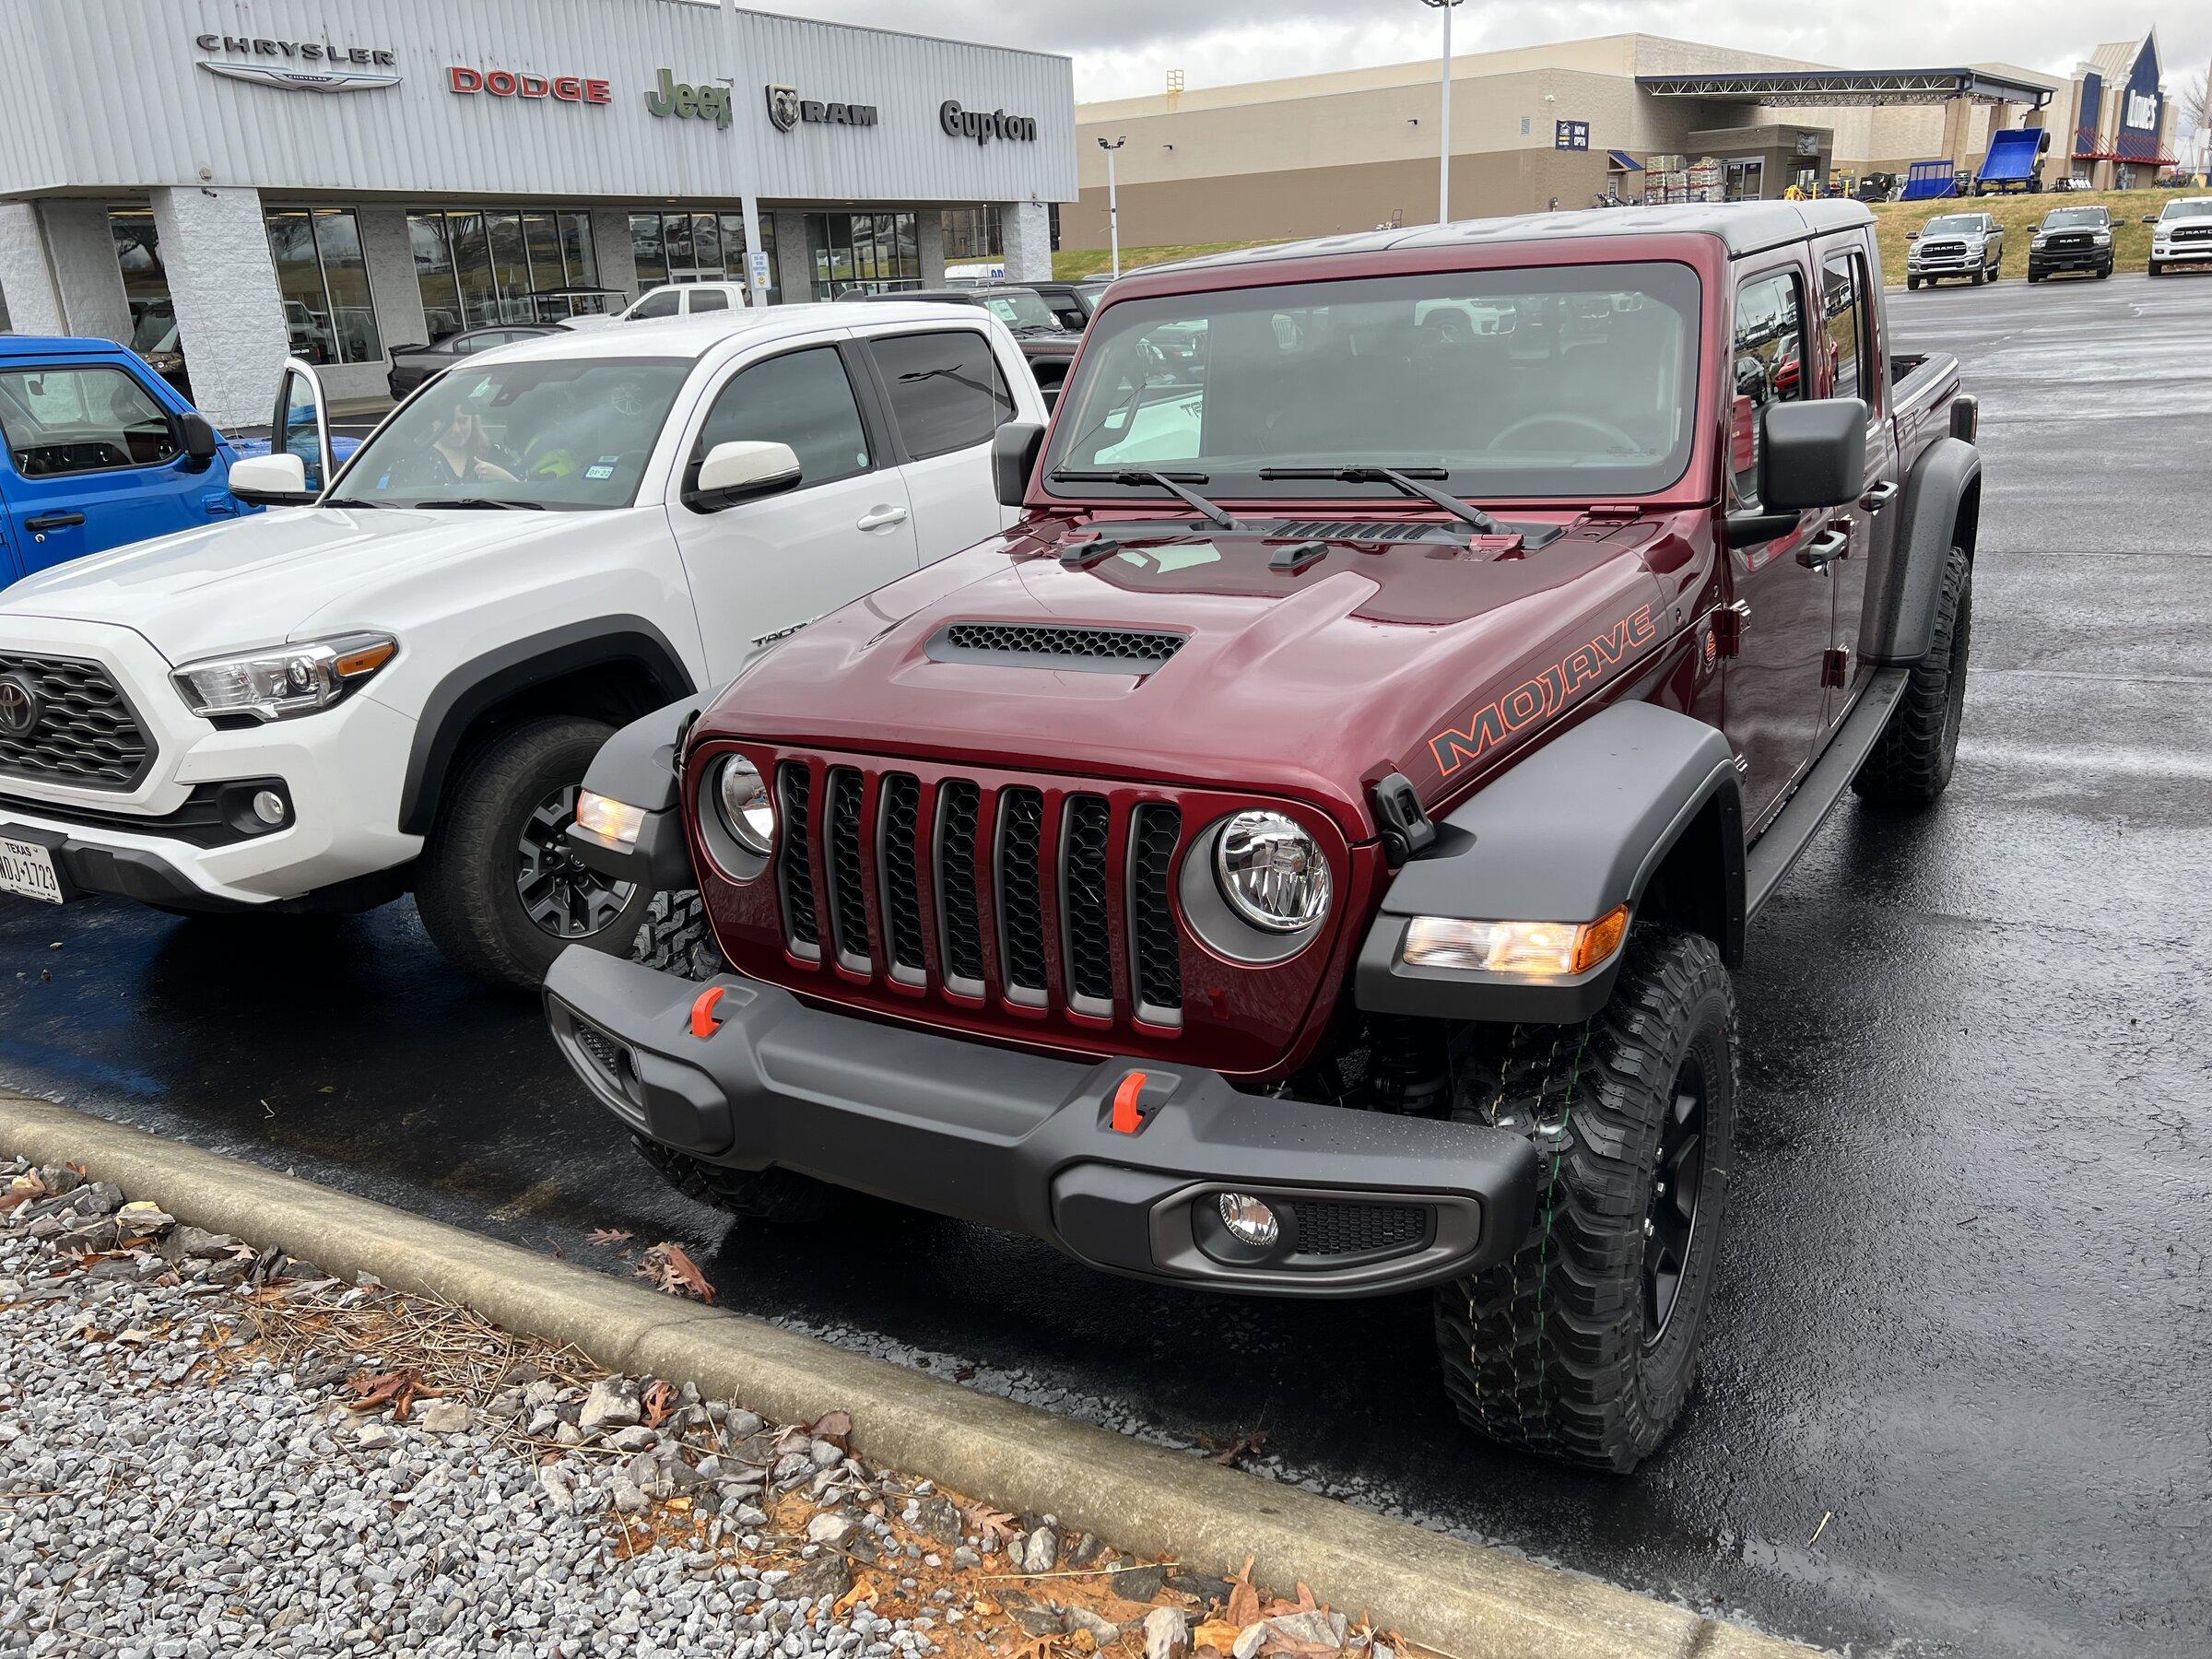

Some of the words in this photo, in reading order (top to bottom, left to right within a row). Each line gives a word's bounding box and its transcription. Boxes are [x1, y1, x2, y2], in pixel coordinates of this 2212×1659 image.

[196, 34, 395, 65] CHRYSLER
[446, 66, 612, 104] DODGE
[644, 67, 733, 130] Jeep
[800, 100, 877, 125] RAM
[939, 100, 1037, 146] Gupton
[1428, 605, 1655, 776] MOJAVE
[5, 841, 32, 857] TEXAS
